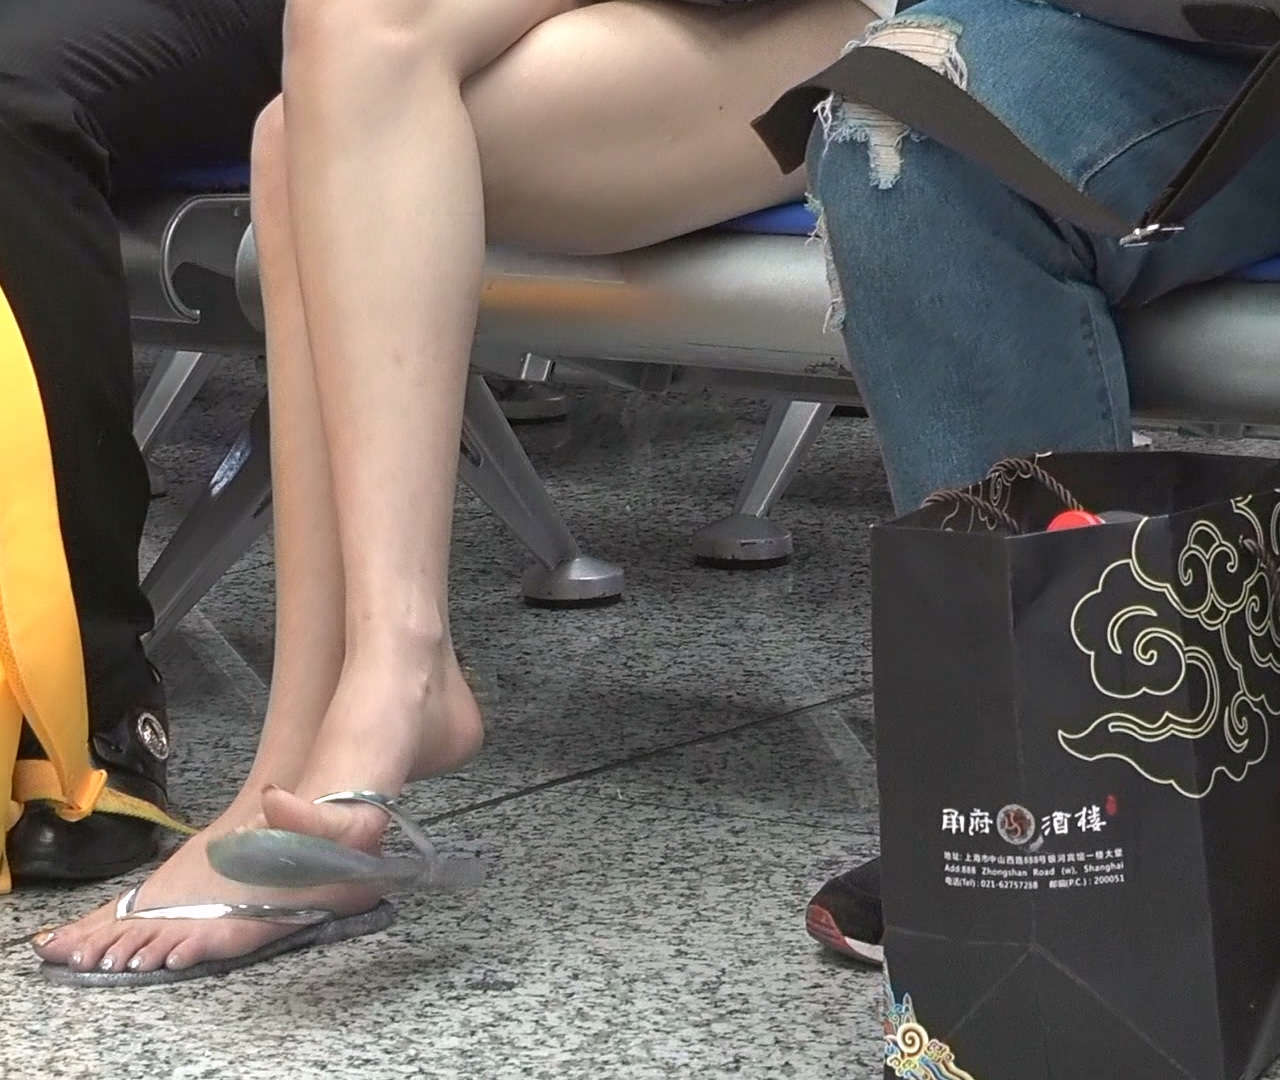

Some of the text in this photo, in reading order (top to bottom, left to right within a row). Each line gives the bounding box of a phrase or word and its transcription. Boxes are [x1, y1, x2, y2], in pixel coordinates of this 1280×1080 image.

[981, 866, 1028, 878] Zhongshan
[1032, 866, 1056, 877] Road
[1083, 860, 1125, 874] Shanghai
[1093, 873, 1126, 886] 200051
